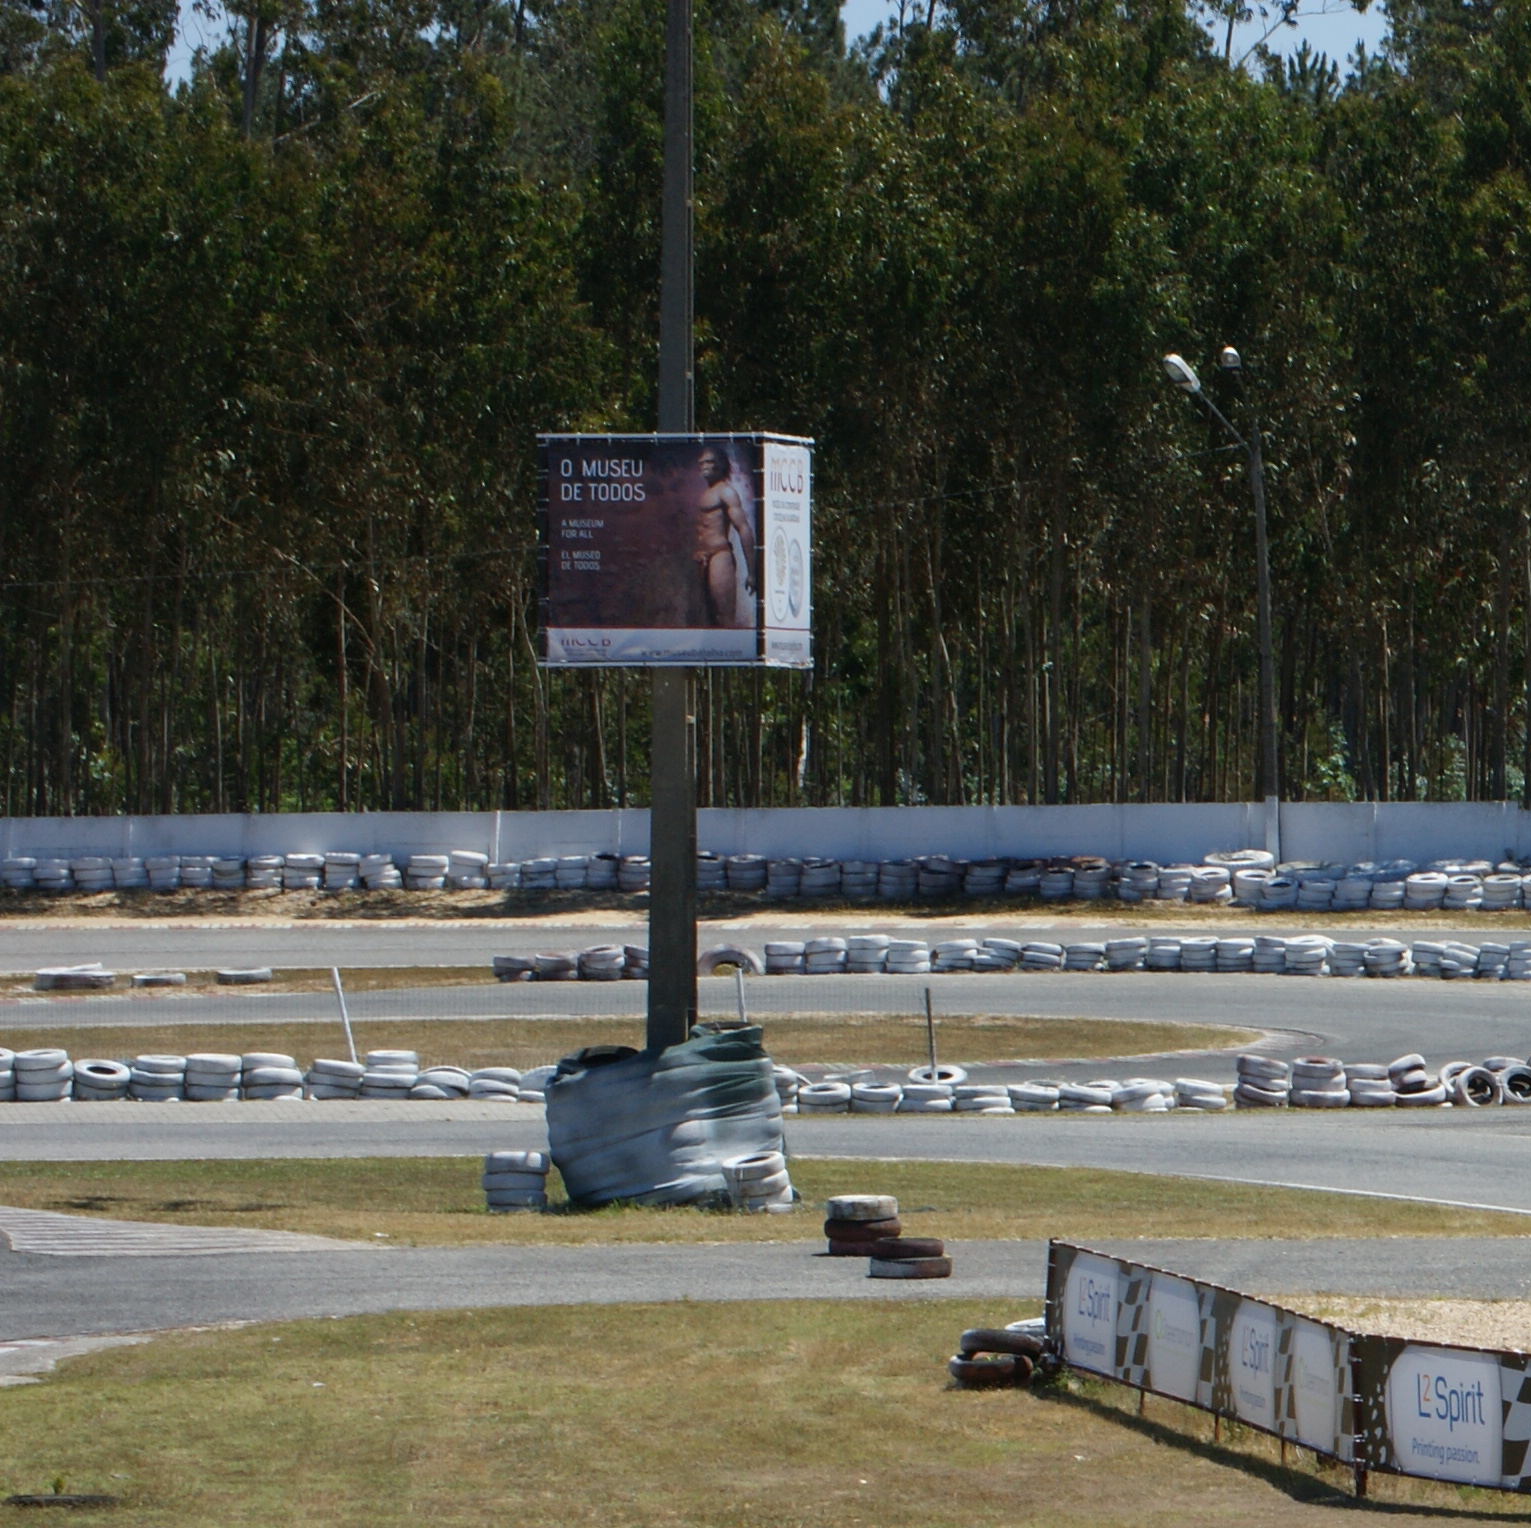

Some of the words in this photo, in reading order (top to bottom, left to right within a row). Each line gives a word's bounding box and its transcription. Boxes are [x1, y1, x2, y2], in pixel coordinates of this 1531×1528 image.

[560, 458, 573, 478] O
[581, 458, 644, 478] MUSEU
[560, 482, 583, 502] DE
[587, 482, 647, 502] TODOS
[569, 519, 604, 528] MUSEUM
[561, 529, 578, 539] FOR
[579, 529, 594, 539] ALL
[561, 550, 570, 560] EL
[561, 560, 571, 571] DE
[573, 560, 601, 571] TODOS
[1434, 1375, 1486, 1432] Spirit
[1411, 1437, 1444, 1465] Printing
